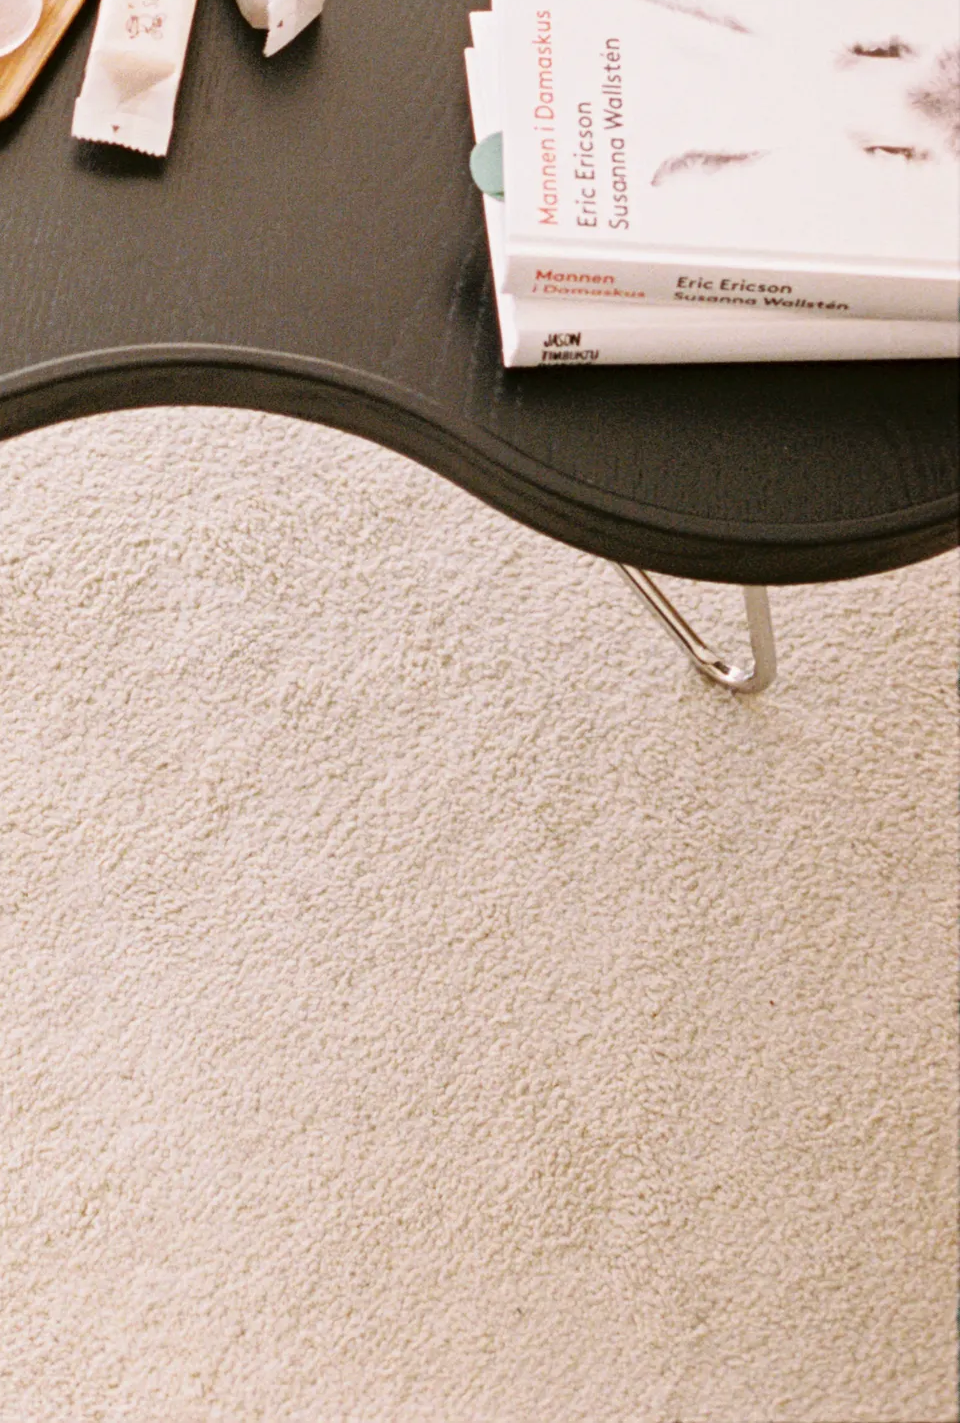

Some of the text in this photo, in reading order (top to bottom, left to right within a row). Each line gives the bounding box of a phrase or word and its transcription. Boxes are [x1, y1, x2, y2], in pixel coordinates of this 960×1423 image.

[531, 9, 555, 120] Damaskus
[598, 37, 630, 231] Susanna Wallstén
[572, 101, 598, 228] Eric Ericson
[537, 138, 559, 226] Mannen
[535, 269, 616, 285] Mannen
[675, 276, 793, 294] Eric Ericson
[531, 284, 646, 299] i Damaskus
[673, 291, 850, 311] Susanna Wallstén
[542, 331, 582, 348] JASON
[541, 349, 601, 362] TIMBUKTU
